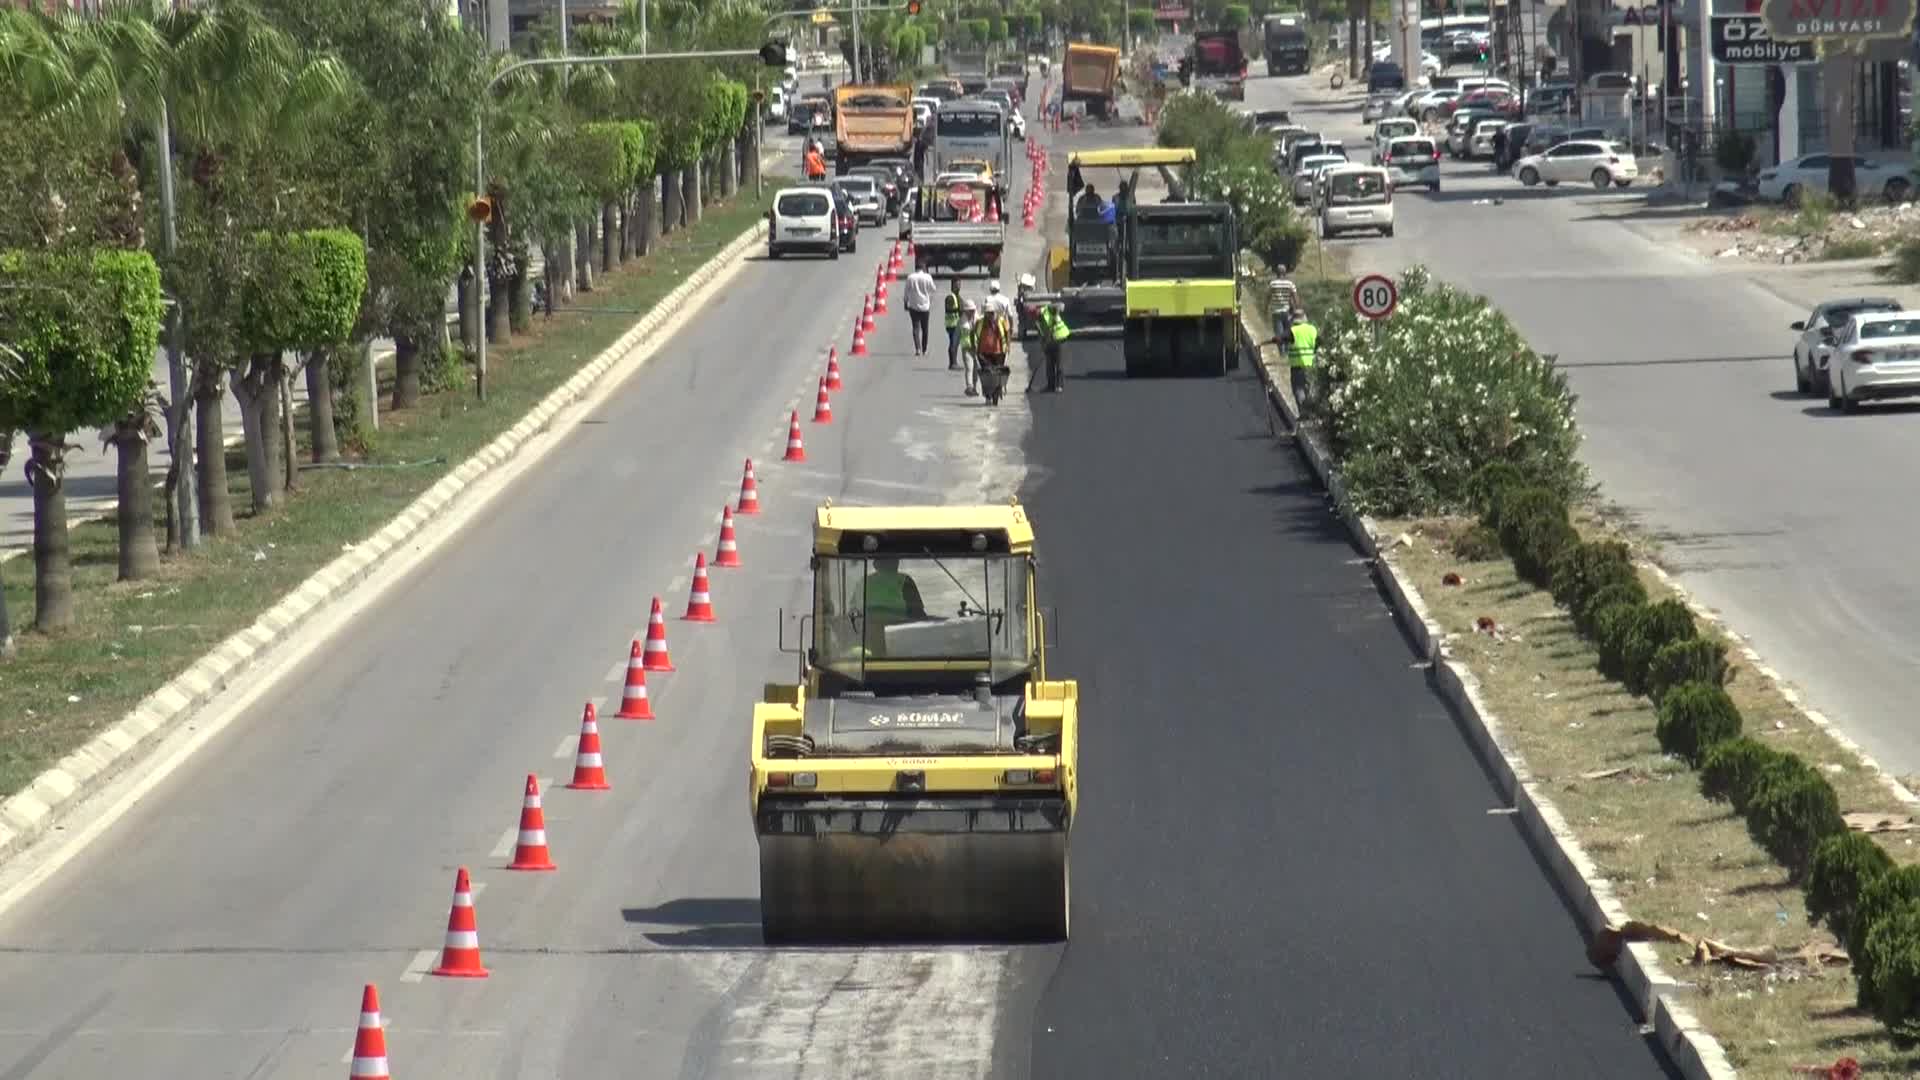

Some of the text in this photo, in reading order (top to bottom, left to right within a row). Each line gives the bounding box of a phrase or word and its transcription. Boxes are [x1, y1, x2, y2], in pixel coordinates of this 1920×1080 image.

[1796, 18, 1881, 34] DÜNYASI
[1726, 43, 1801, 60] mobilya
[1363, 287, 1388, 307] 80
